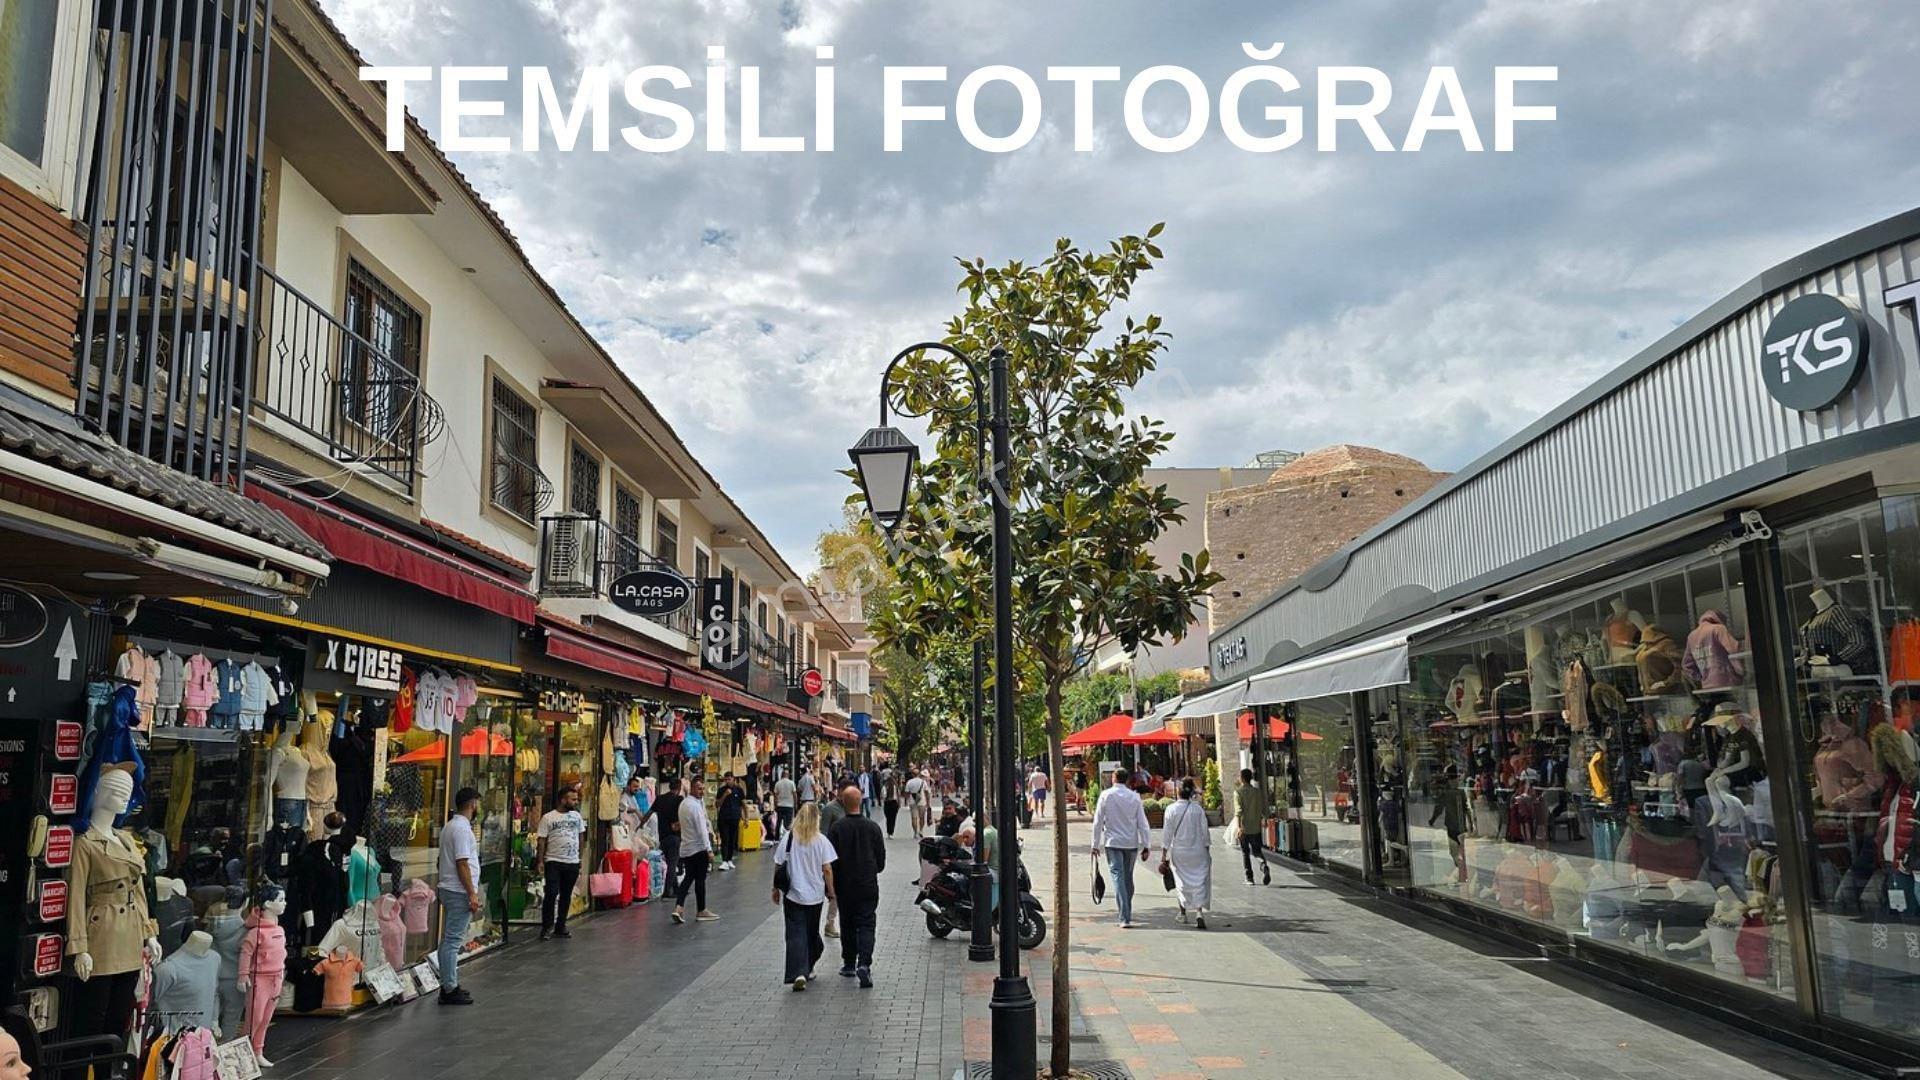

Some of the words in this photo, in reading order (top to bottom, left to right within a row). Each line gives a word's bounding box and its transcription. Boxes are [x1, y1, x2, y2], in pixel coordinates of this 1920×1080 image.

[1766, 317, 1852, 384] TKS
[615, 584, 685, 598] LA.CASA
[708, 583, 725, 664] ICON
[324, 640, 339, 671] X
[344, 643, 402, 692] CLASS
[443, 696, 454, 716] 10
